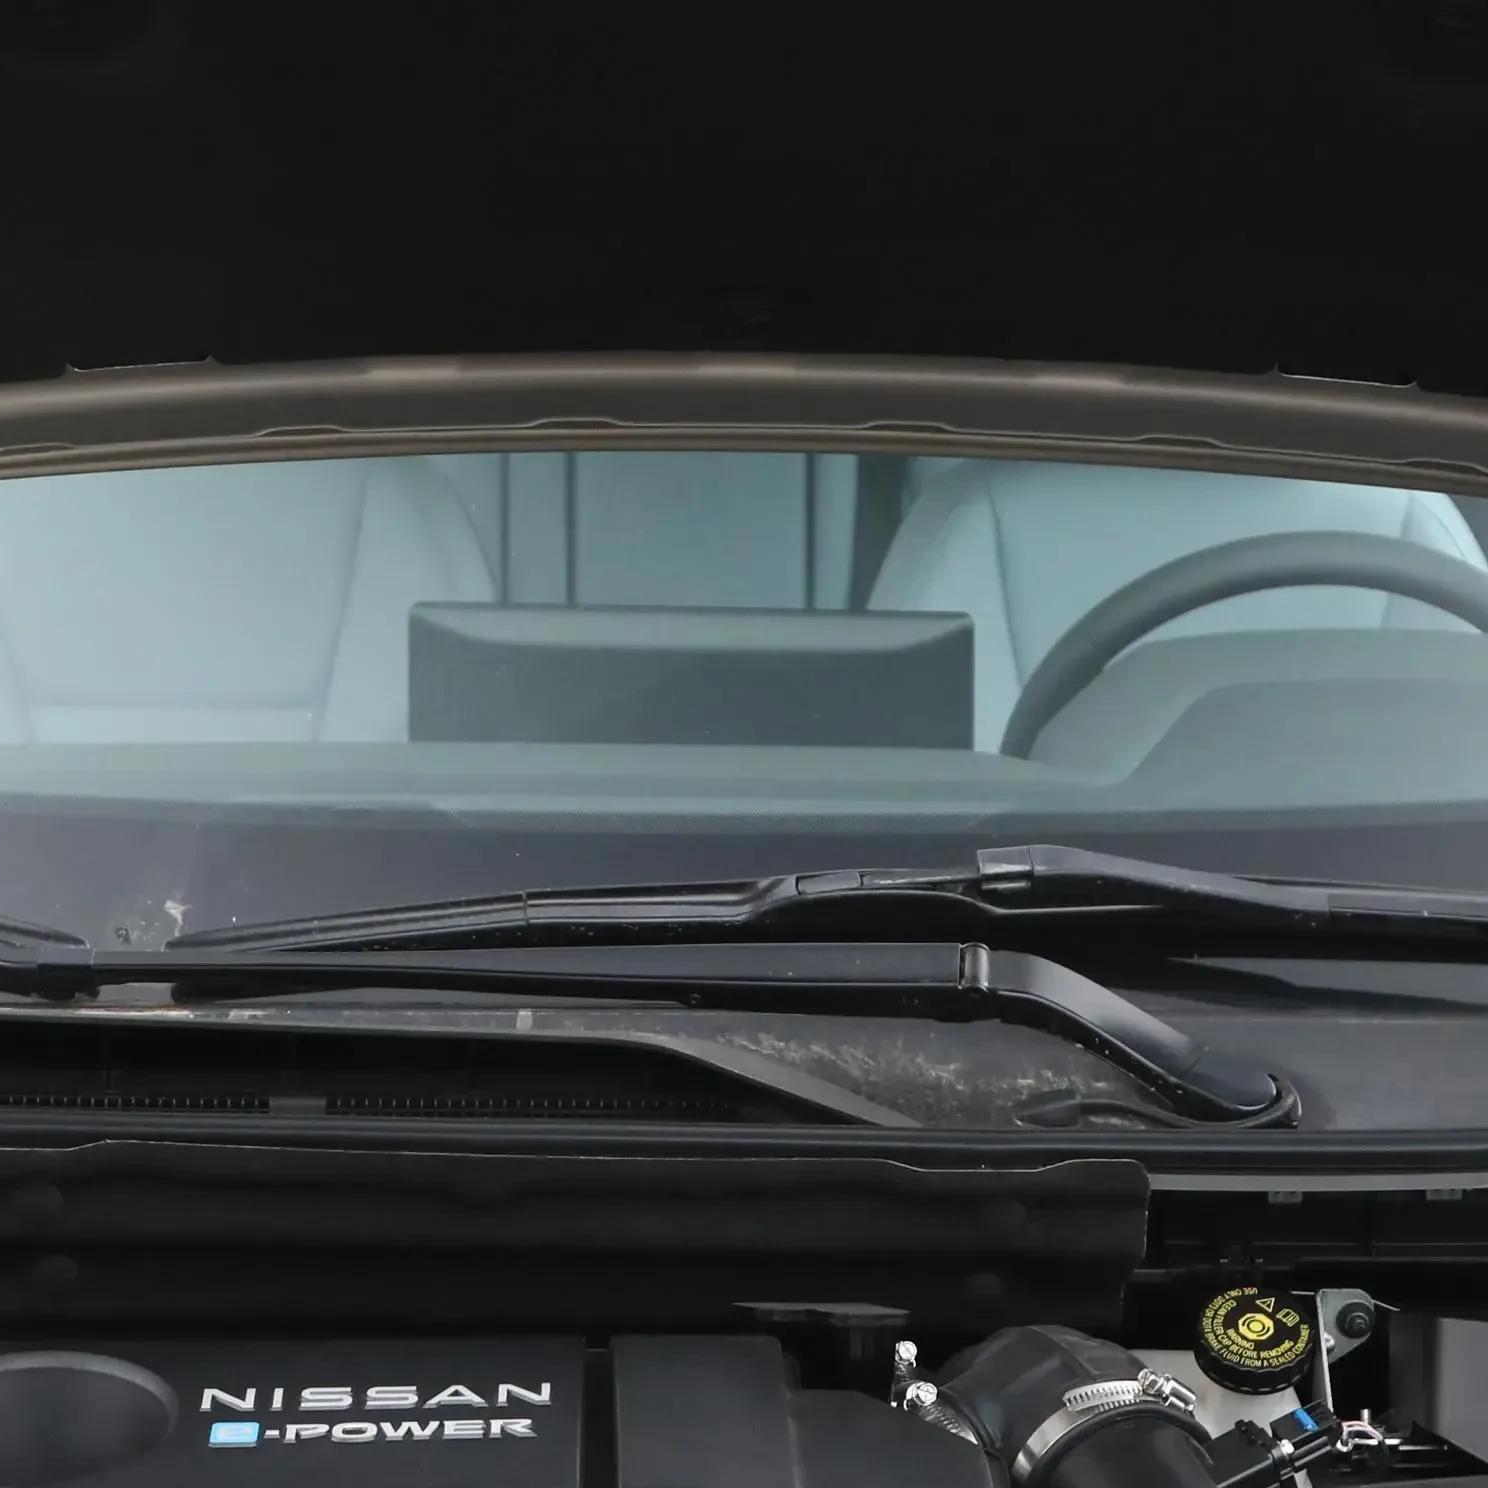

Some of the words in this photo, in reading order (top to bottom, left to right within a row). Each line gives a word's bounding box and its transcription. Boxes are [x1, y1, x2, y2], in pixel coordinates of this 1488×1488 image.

[1216, 1299, 1237, 1316] CLEAN
[1213, 1314, 1224, 1335] FILLER
[1218, 1334, 1232, 1346] CAP
[1225, 1327, 1255, 1350] WARNING
[1204, 1332, 1223, 1352] BRAKE
[1219, 1348, 1240, 1363] FLUID
[1240, 1357, 1262, 1367] FROM
[1263, 1359, 1270, 1367] A
[1269, 1351, 1295, 1366] SEALED
[1229, 1344, 1258, 1359] BEFORE
[1259, 1339, 1295, 1359] REMOVING
[199, 1382, 552, 1412] NISSAN
